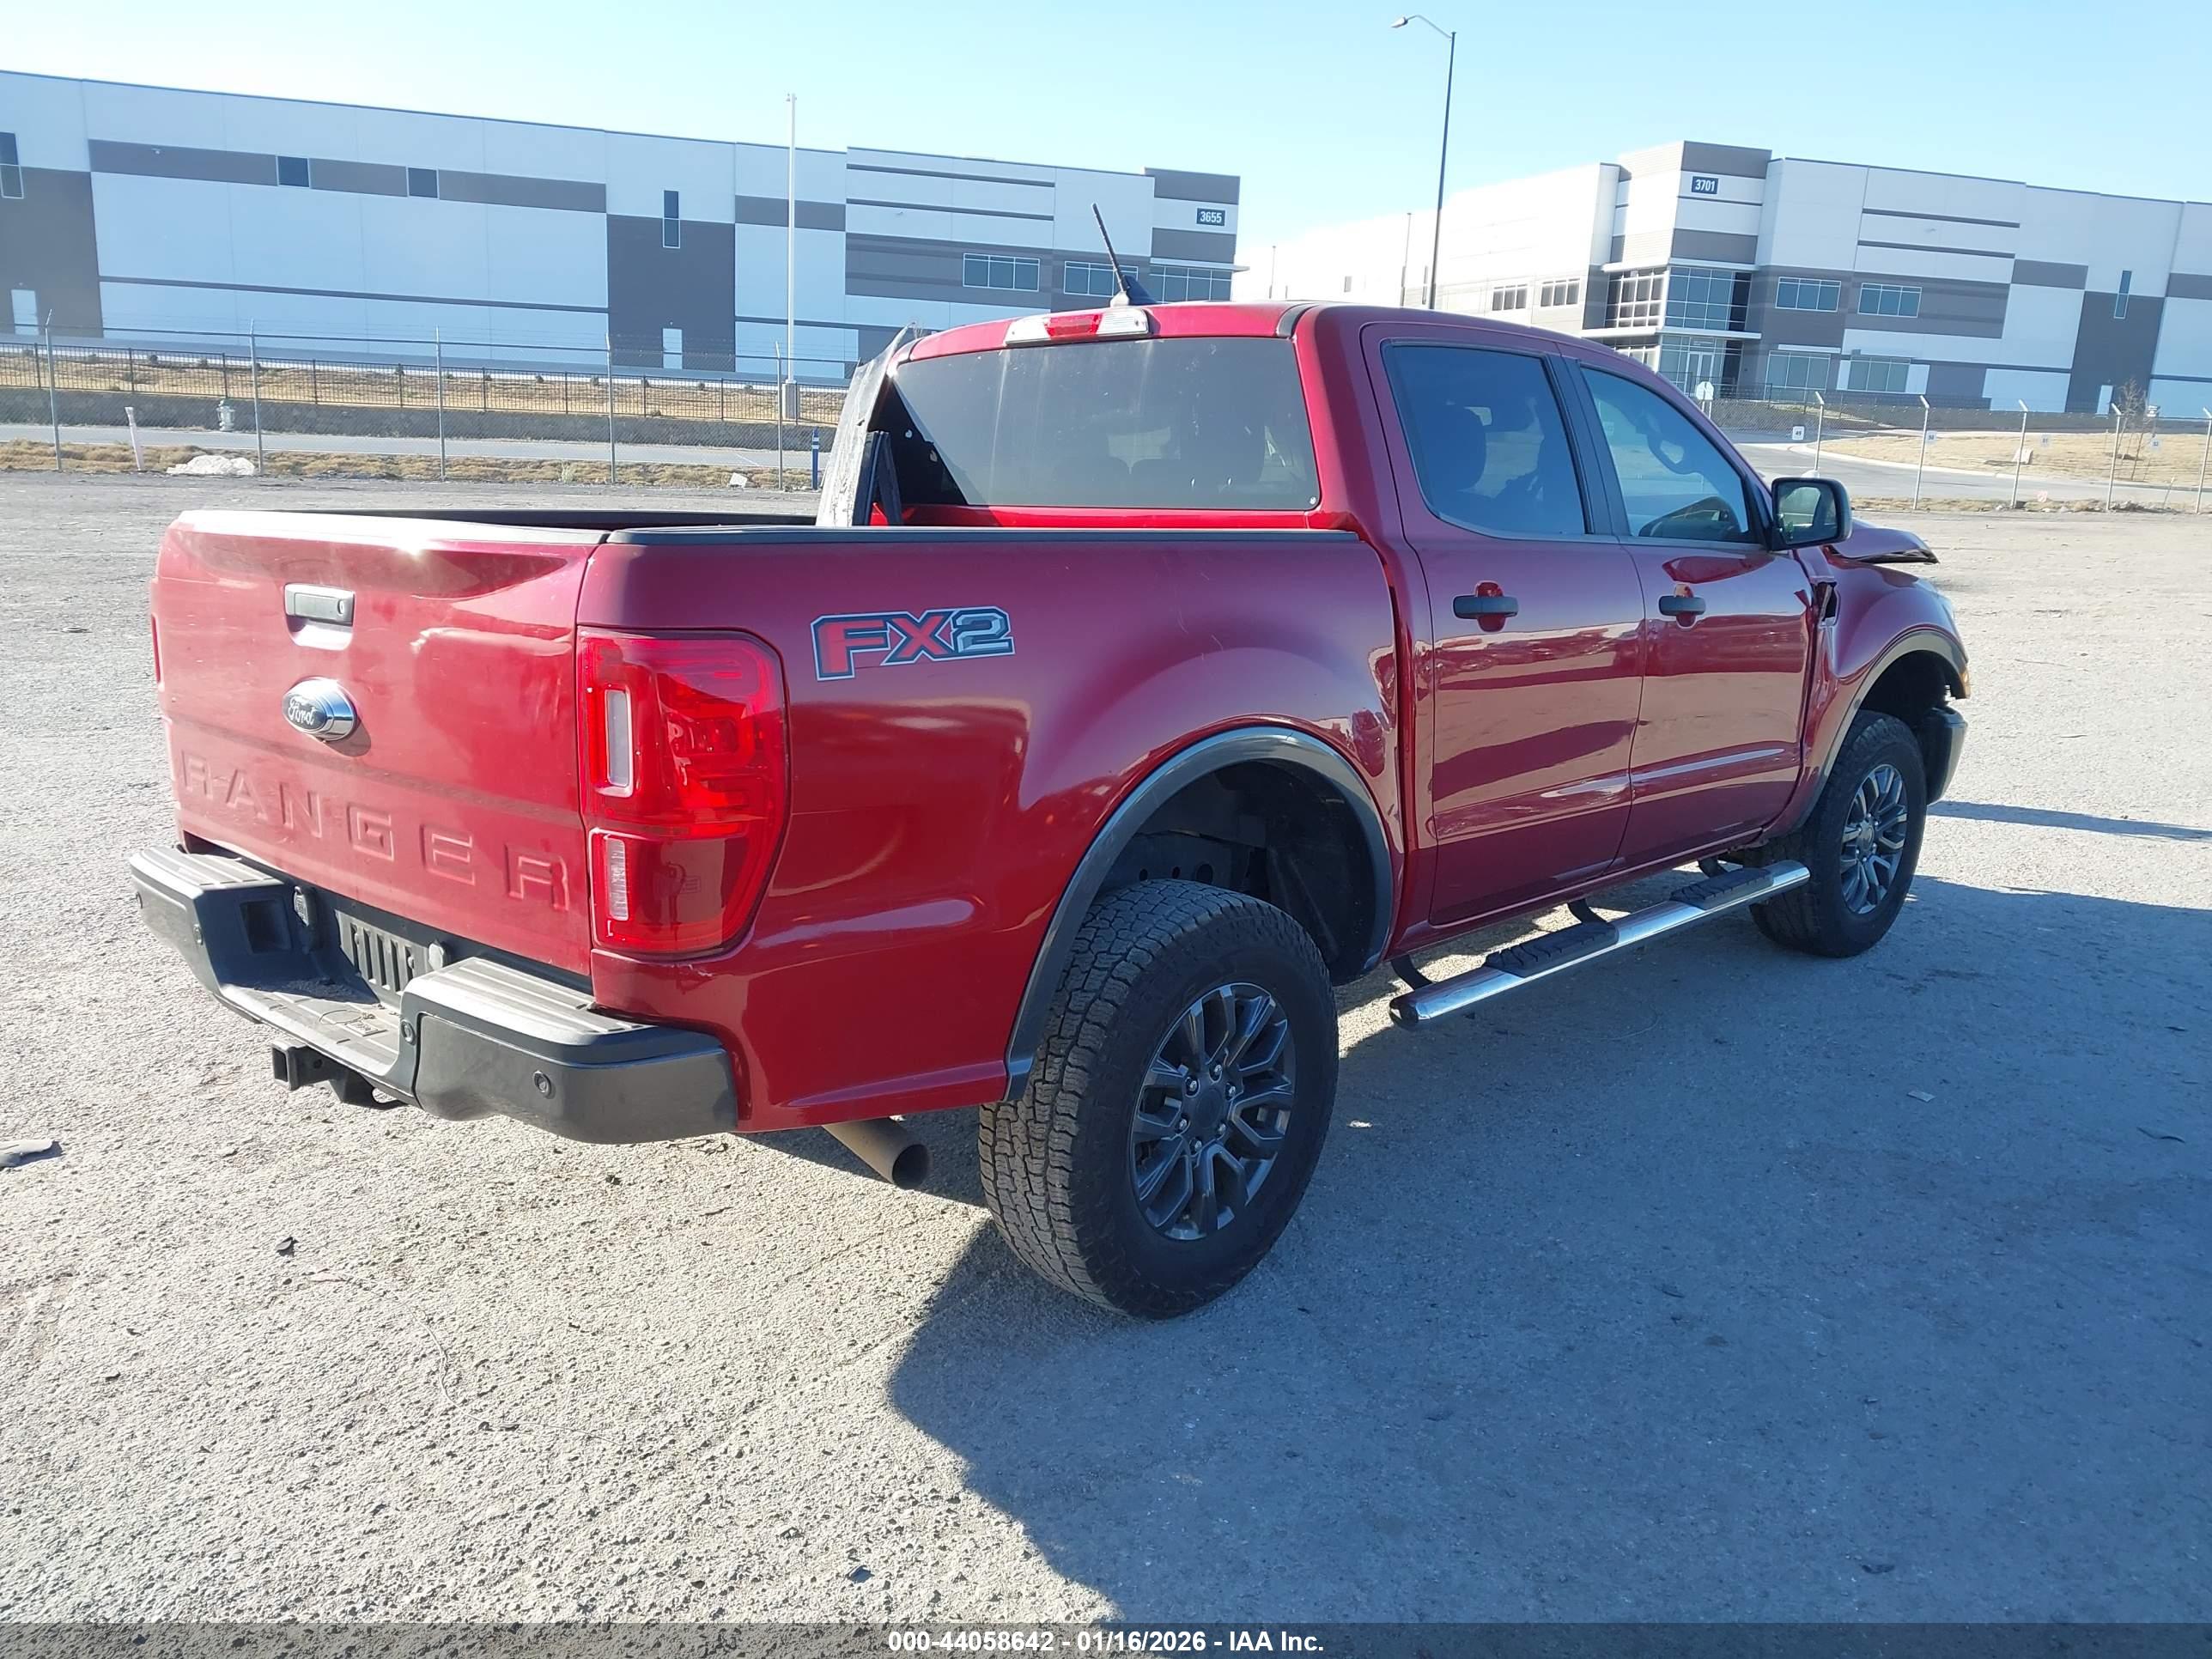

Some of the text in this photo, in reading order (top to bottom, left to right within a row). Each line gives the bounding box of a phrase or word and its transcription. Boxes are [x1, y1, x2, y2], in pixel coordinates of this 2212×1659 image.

[1695, 179, 1716, 191] 3701
[1200, 210, 1222, 223] 3655
[811, 605, 1016, 681] FX2
[288, 696, 318, 726] Ford
[180, 749, 570, 912] RANGER
